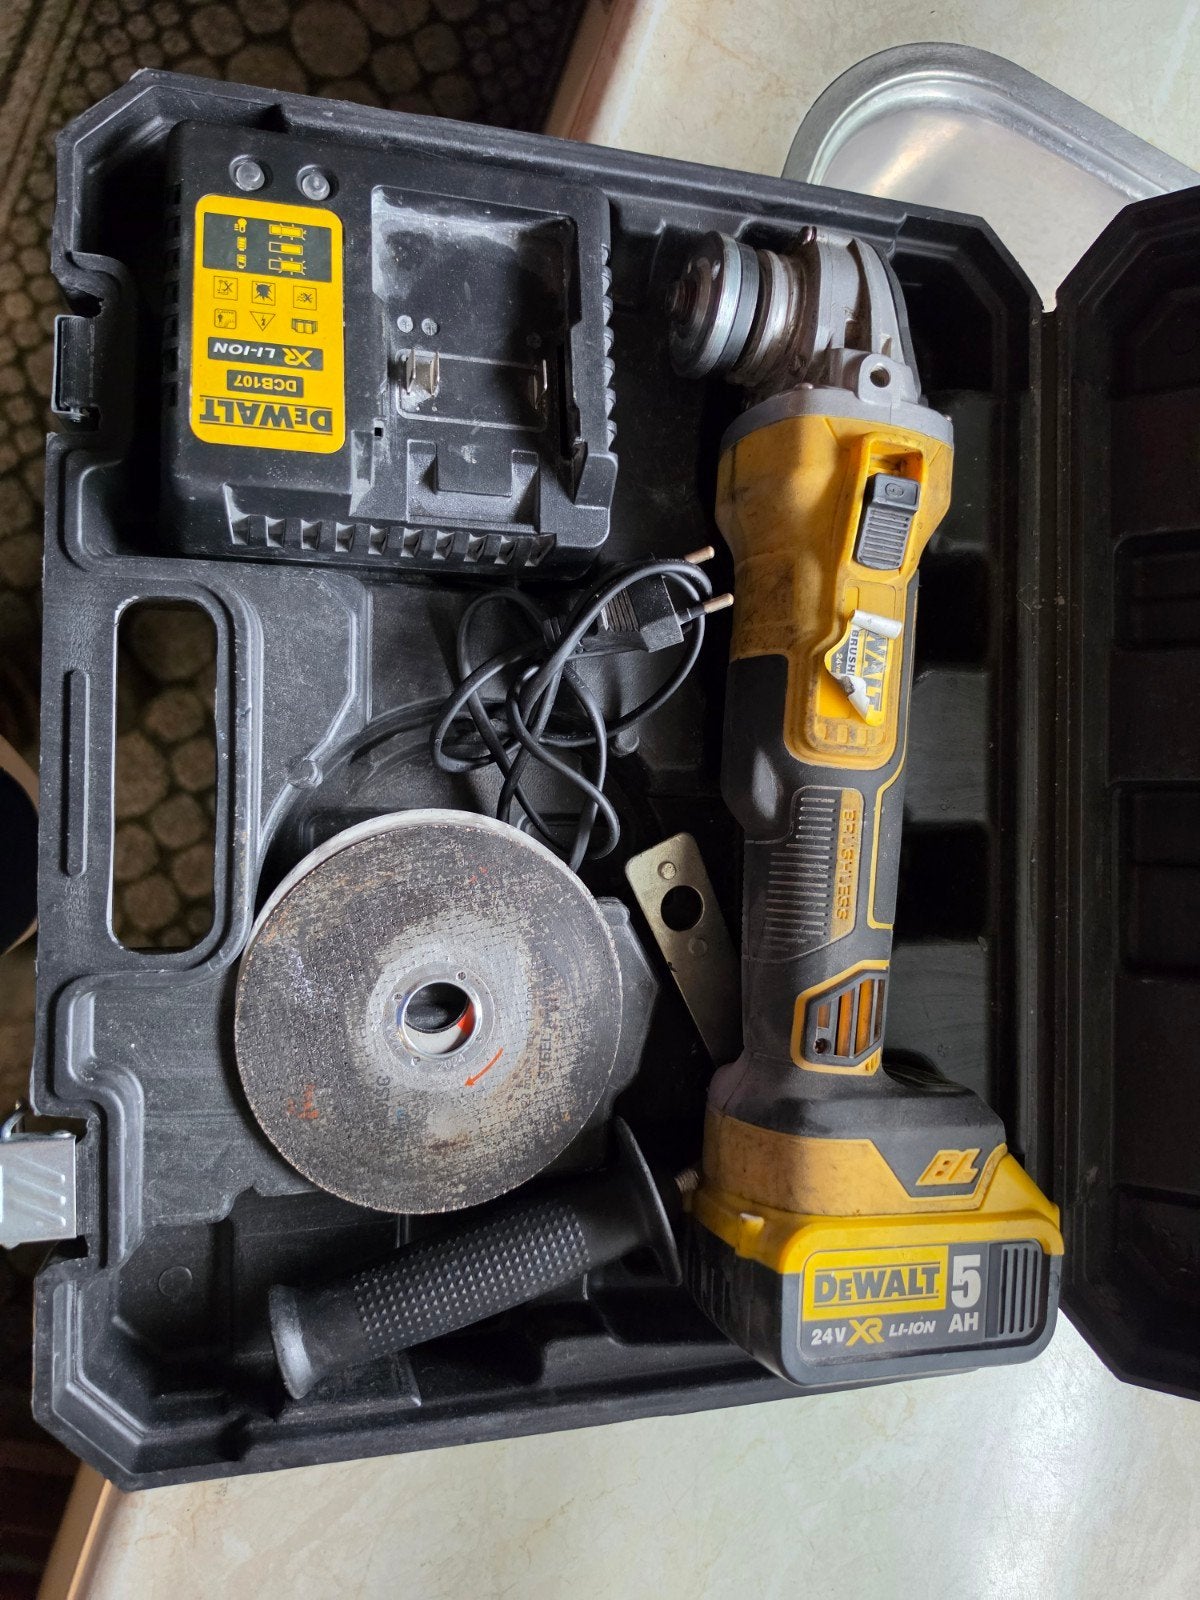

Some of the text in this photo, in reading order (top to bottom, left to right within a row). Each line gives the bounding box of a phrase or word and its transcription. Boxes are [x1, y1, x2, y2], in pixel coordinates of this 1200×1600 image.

[213, 342, 313, 368] XR LI-ION
[233, 375, 297, 393] DCB107
[847, 630, 859, 676] BRUSH
[836, 810, 857, 920] BRUSHLESS
[915, 1148, 981, 1187] BL
[951, 1254, 981, 1309] 5
[811, 1312, 979, 1347] 24V XR LI-ION AH
